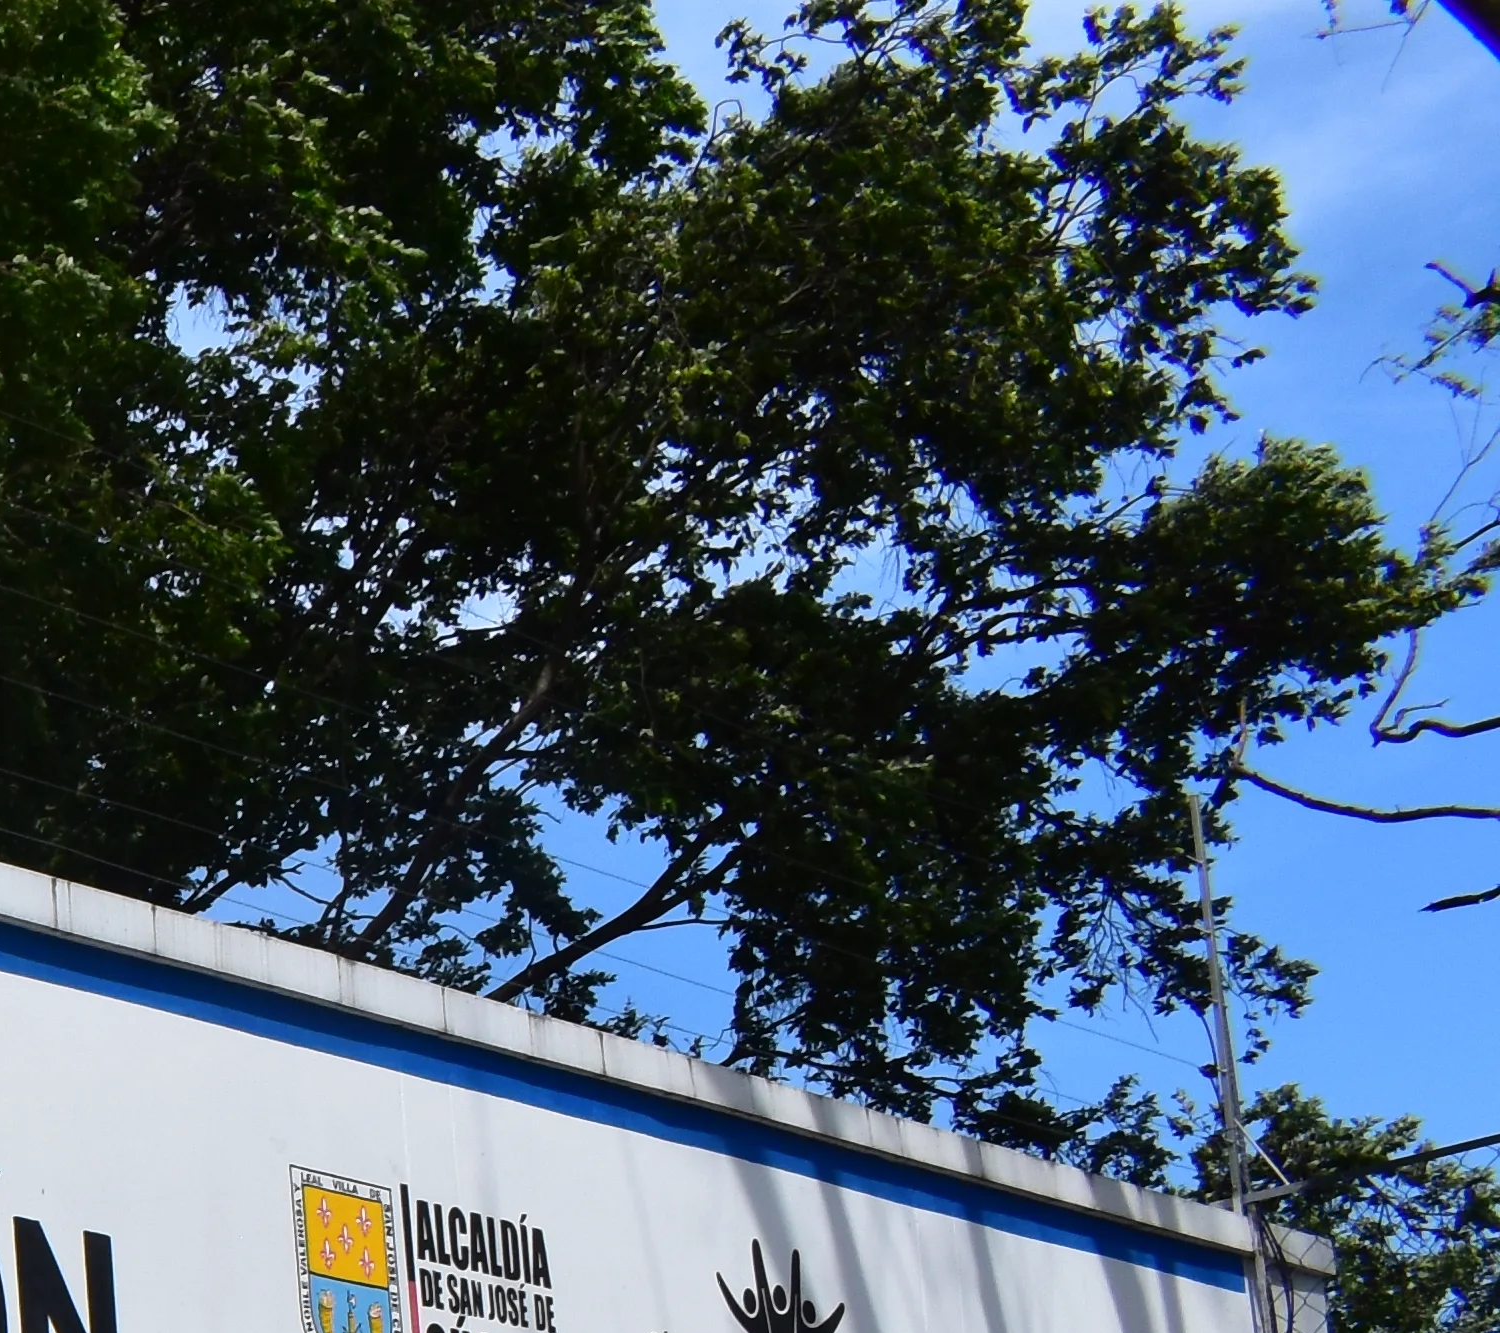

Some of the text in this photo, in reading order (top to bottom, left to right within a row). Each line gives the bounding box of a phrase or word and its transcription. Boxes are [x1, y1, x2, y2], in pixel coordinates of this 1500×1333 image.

[300, 1172, 324, 1187] LEAL
[332, 1179, 359, 1196] VILLA
[415, 1199, 553, 1290] ALCALDÍA
[419, 1268, 445, 1311] DE
[446, 1272, 485, 1319] SAN
[487, 1281, 530, 1329] JOSÉ
